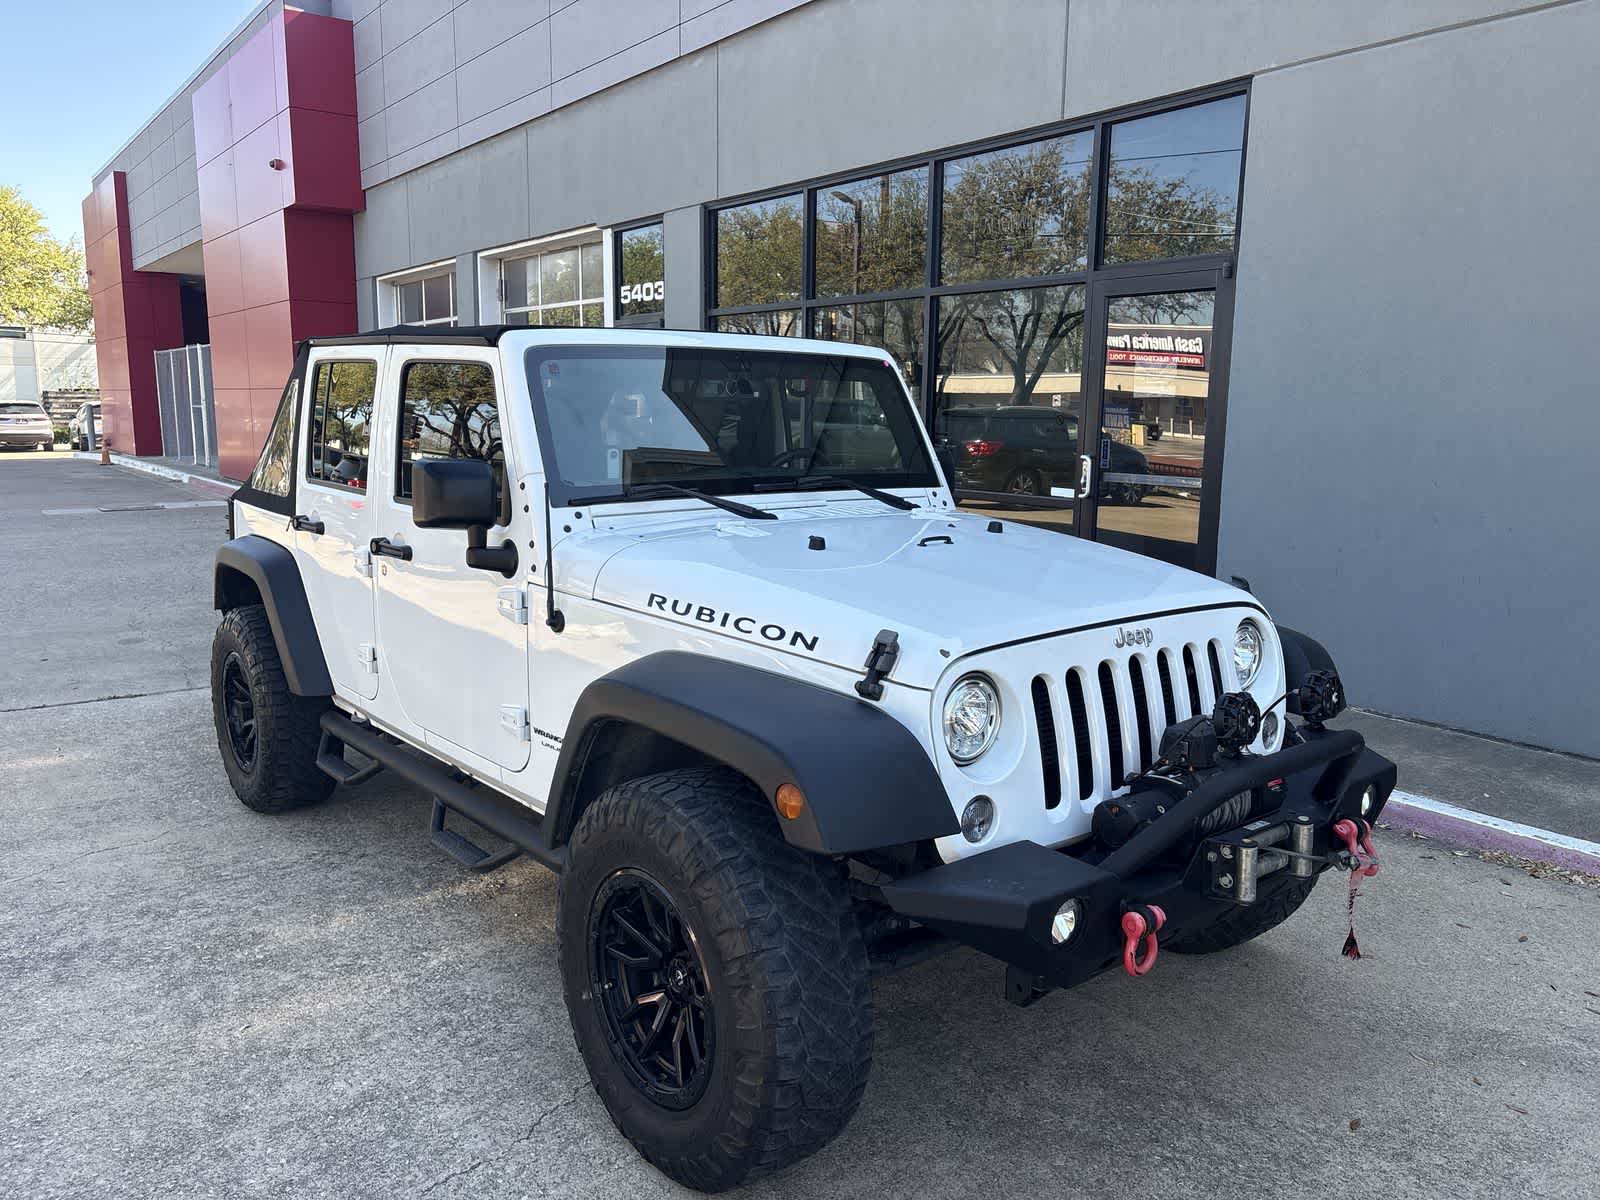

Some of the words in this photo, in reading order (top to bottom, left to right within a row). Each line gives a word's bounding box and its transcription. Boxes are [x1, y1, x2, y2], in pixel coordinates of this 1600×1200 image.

[620, 280, 664, 304] 5403
[647, 592, 820, 652] RUBICON
[1113, 626, 1154, 649] Jeep
